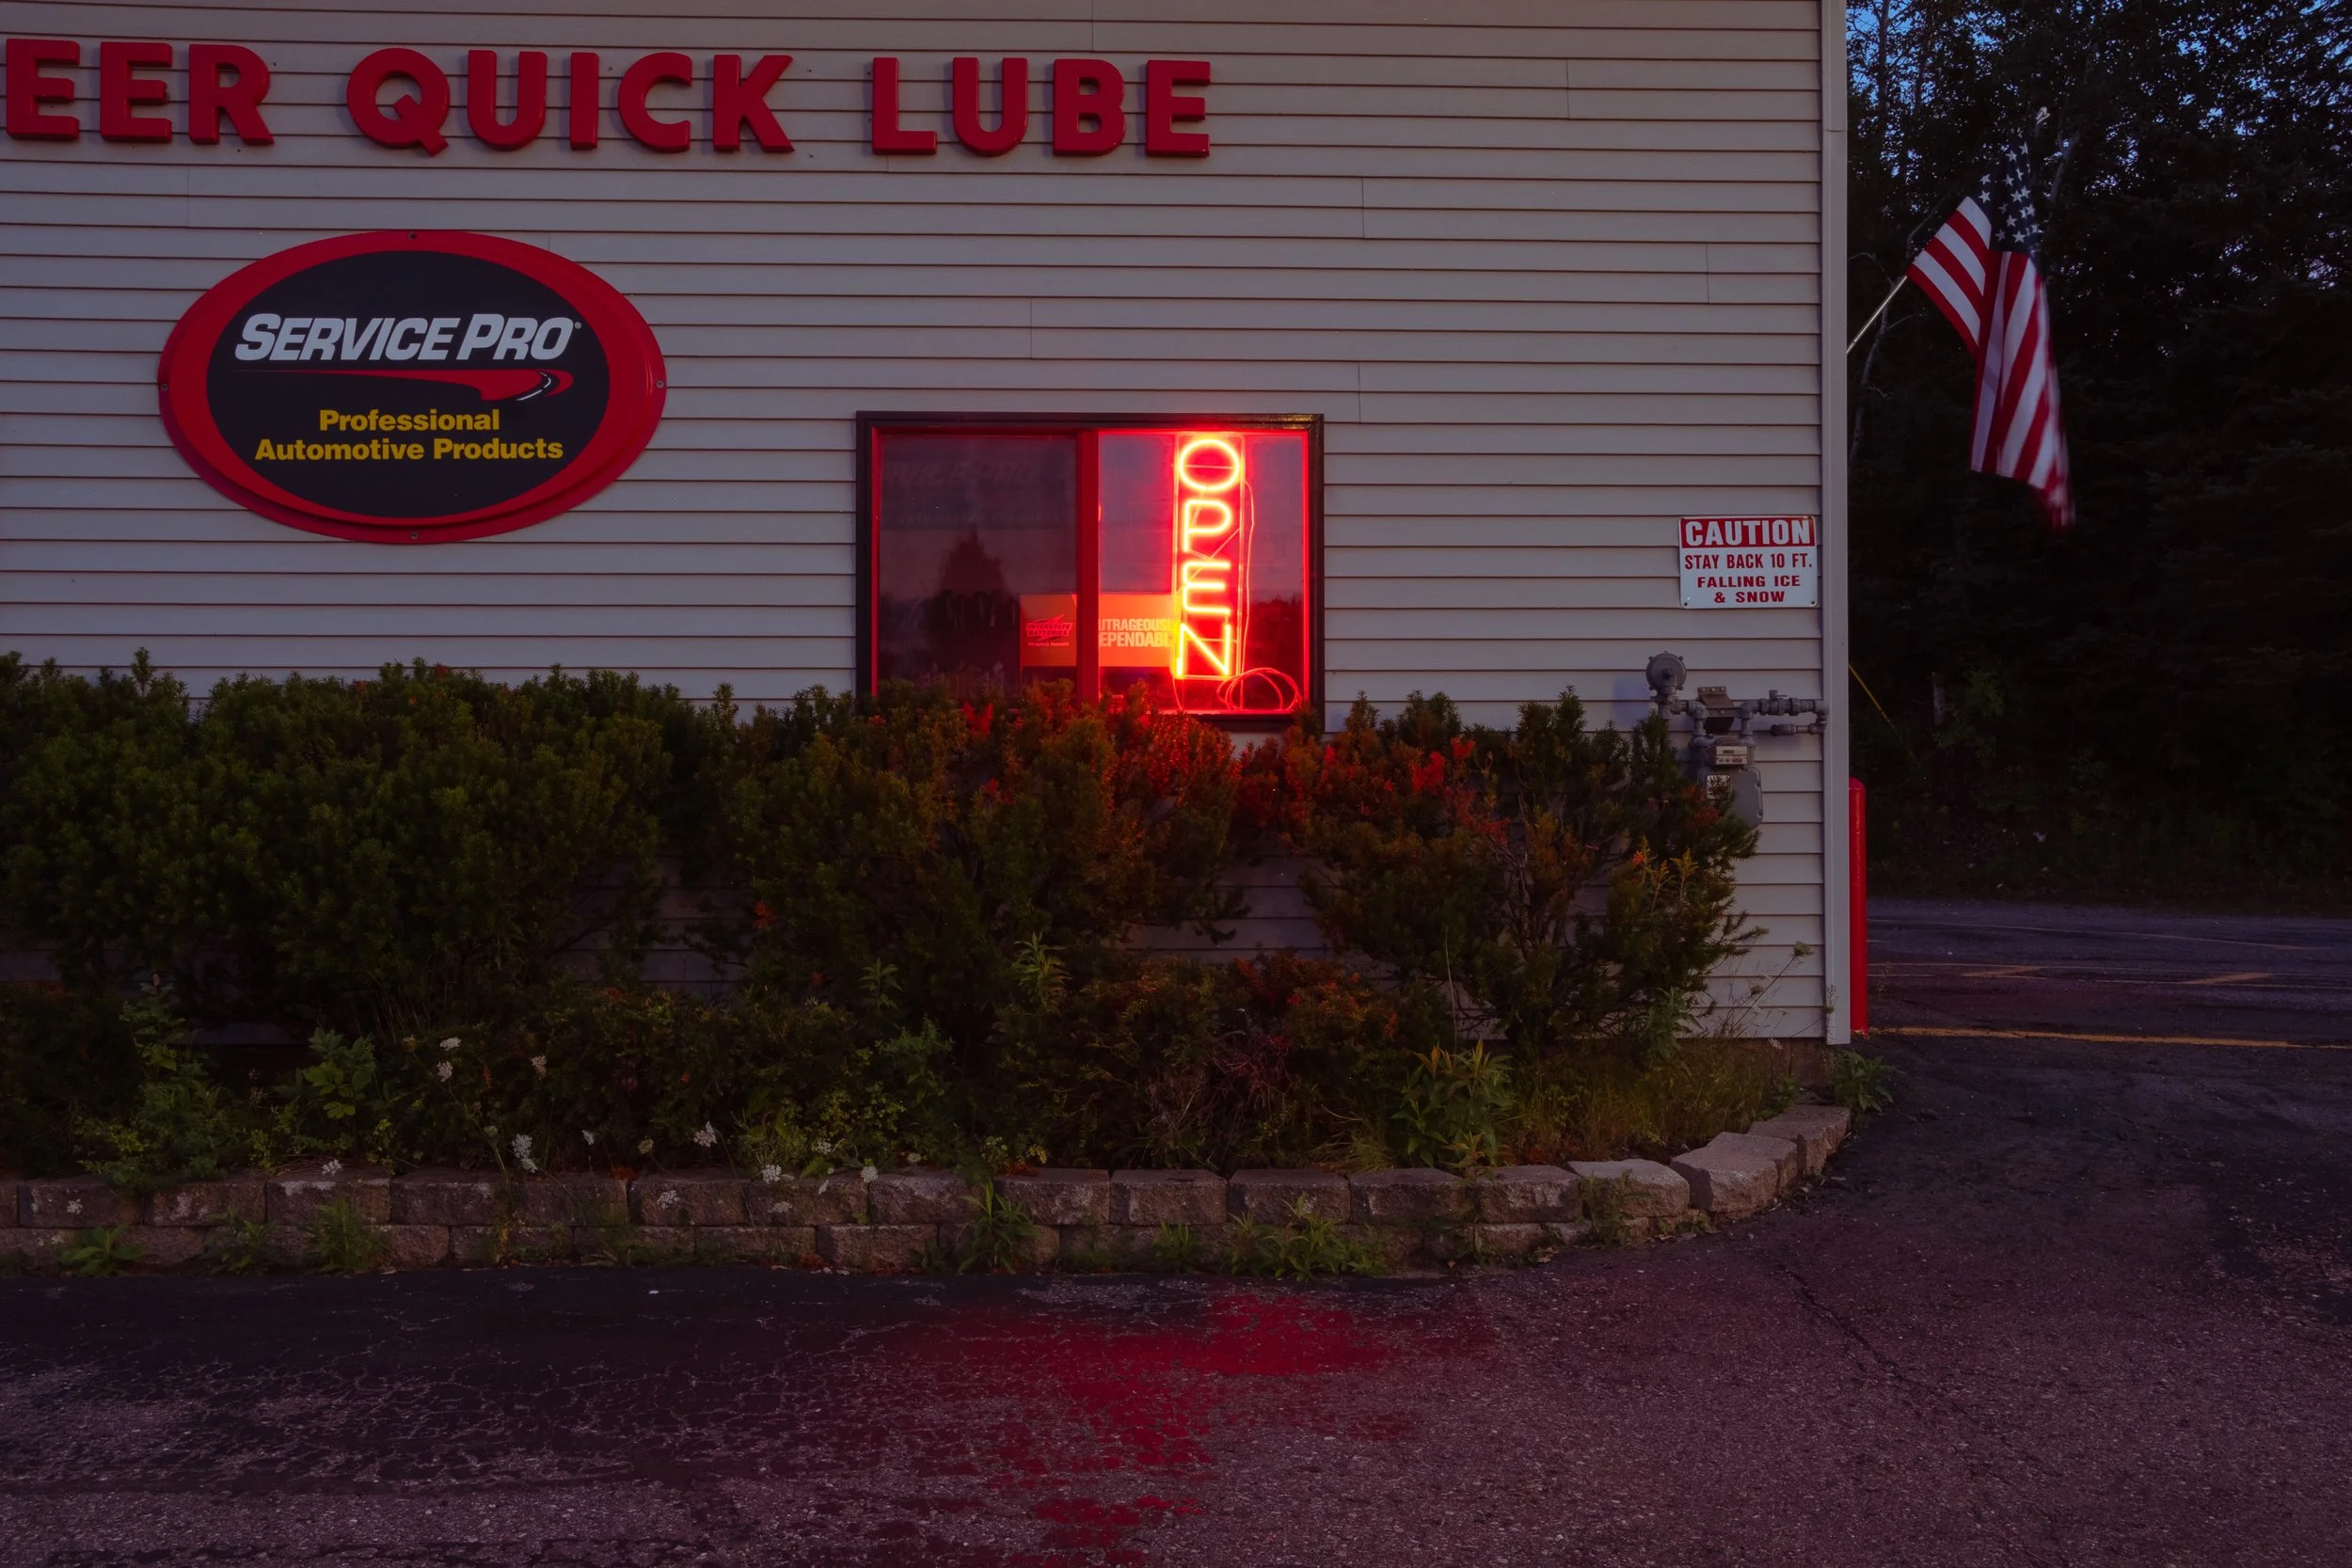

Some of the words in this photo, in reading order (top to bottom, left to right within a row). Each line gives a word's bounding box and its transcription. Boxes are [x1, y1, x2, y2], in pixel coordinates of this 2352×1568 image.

[5, 38, 275, 146] EER
[345, 47, 795, 157] QUICK
[871, 56, 1212, 158] LUBE
[234, 313, 461, 361] SERVICE
[319, 408, 500, 432] Professional
[254, 438, 424, 461] Automotive
[433, 437, 564, 460] Products
[1685, 519, 1811, 546] CAUTION
[1175, 437, 1242, 680] OPEN
[1684, 554, 1720, 570] STAY
[1726, 553, 1764, 569] BACK
[1770, 552, 1785, 568] 10
[1791, 552, 1812, 568] FT.
[1697, 576, 1765, 588] FALLING
[1774, 575, 1801, 587] ICE
[1713, 592, 1725, 604] &
[1735, 591, 1786, 604] SNOW
